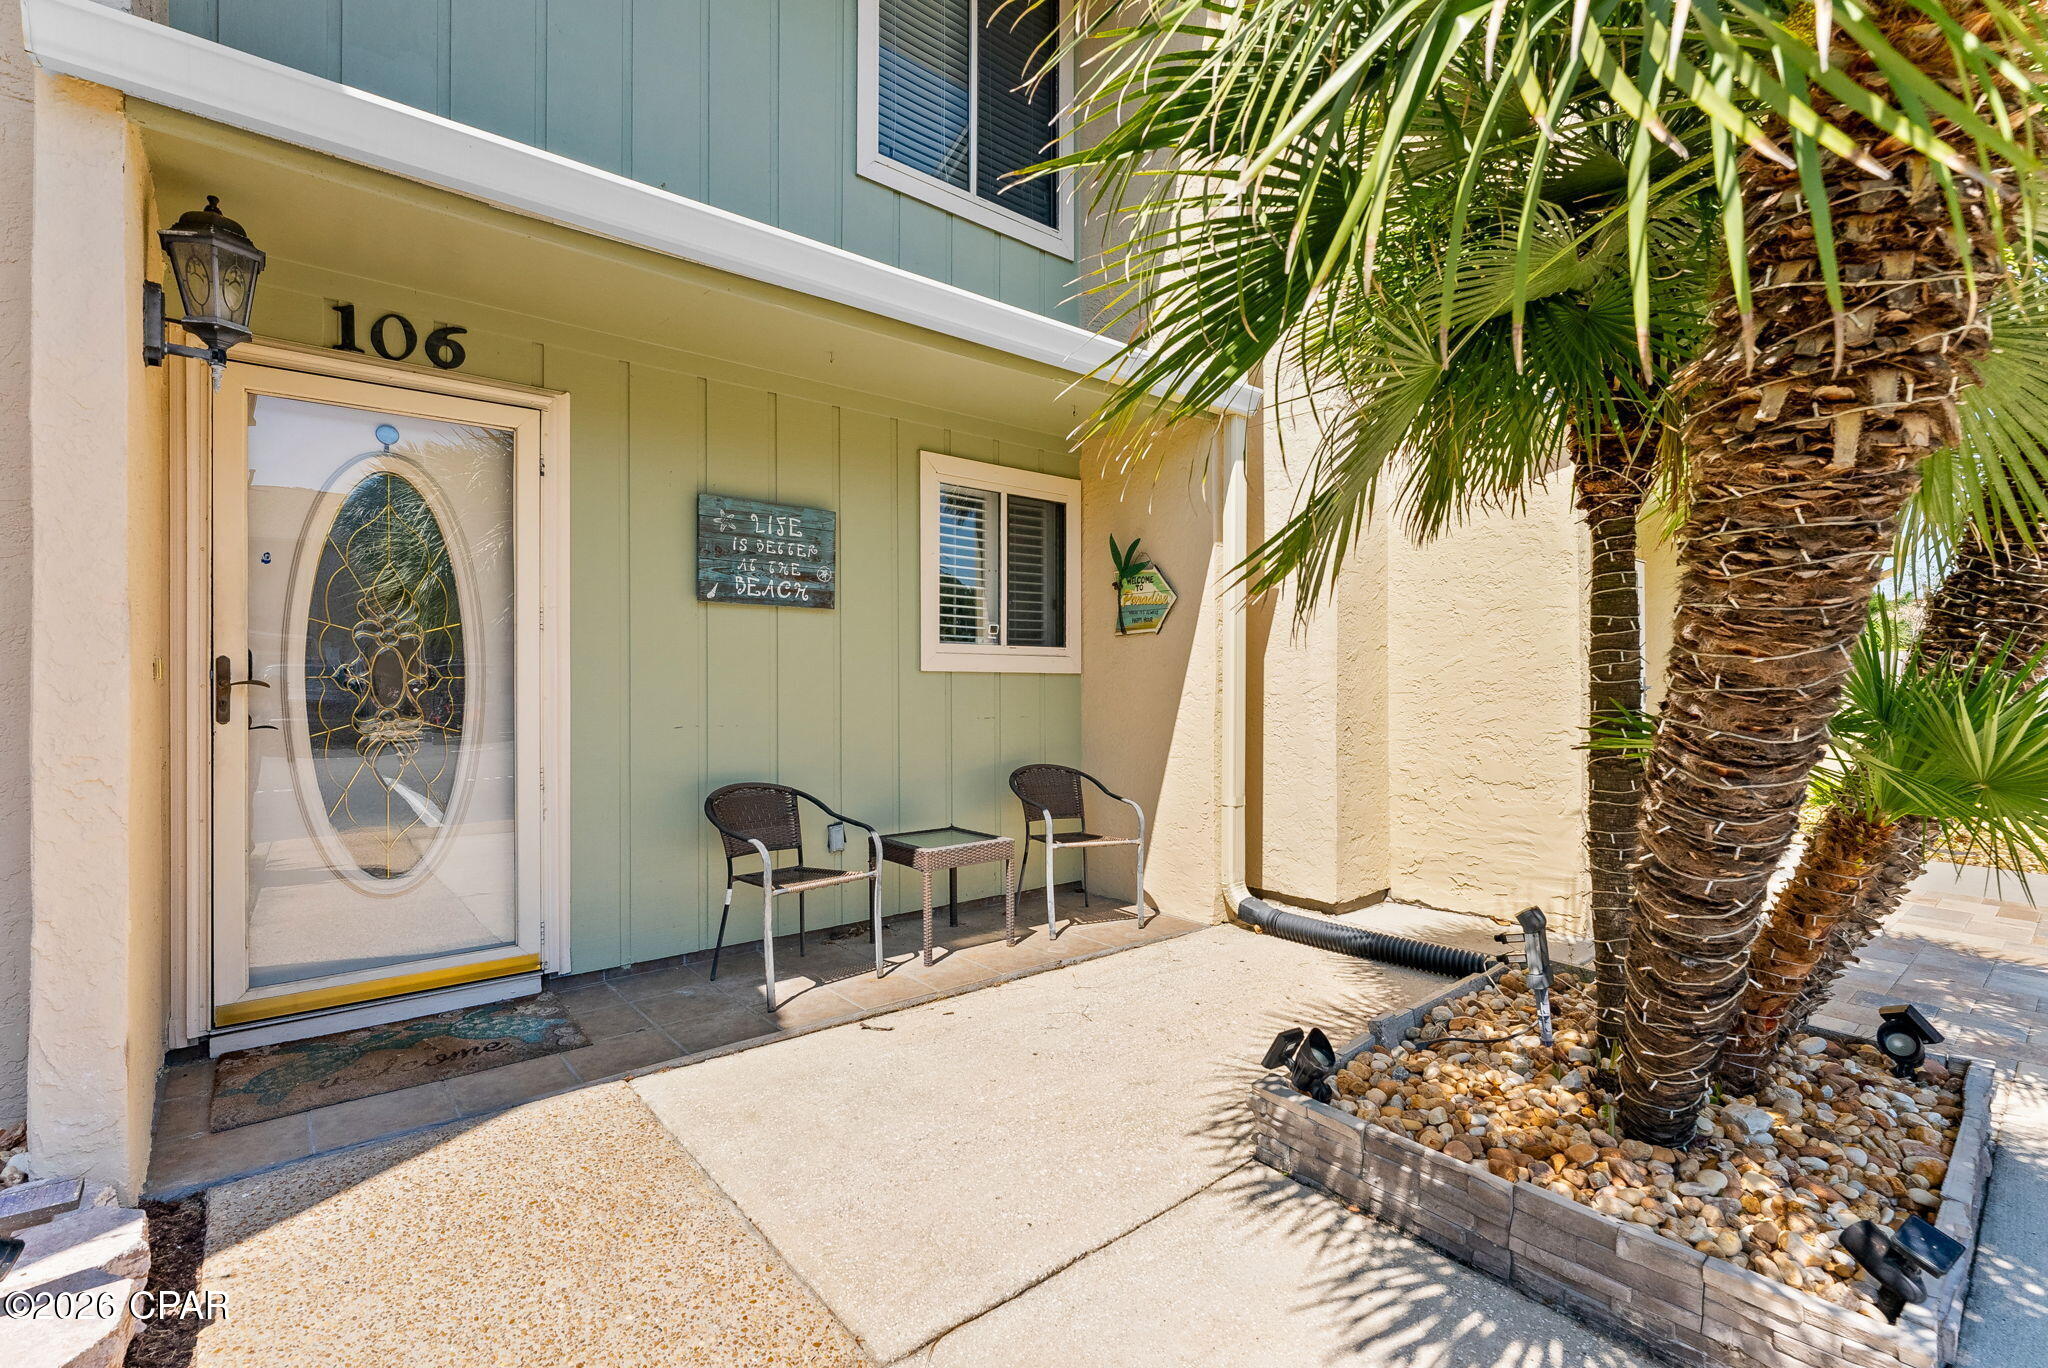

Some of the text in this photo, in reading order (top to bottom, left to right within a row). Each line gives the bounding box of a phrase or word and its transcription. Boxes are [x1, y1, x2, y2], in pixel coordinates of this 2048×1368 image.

[332, 304, 468, 370] 106
[750, 513, 803, 538] LIFE
[756, 540, 818, 558] BETTER
[737, 558, 801, 576] AT THE
[735, 576, 809, 602] BEACH
[1127, 576, 1154, 585] WELCOME
